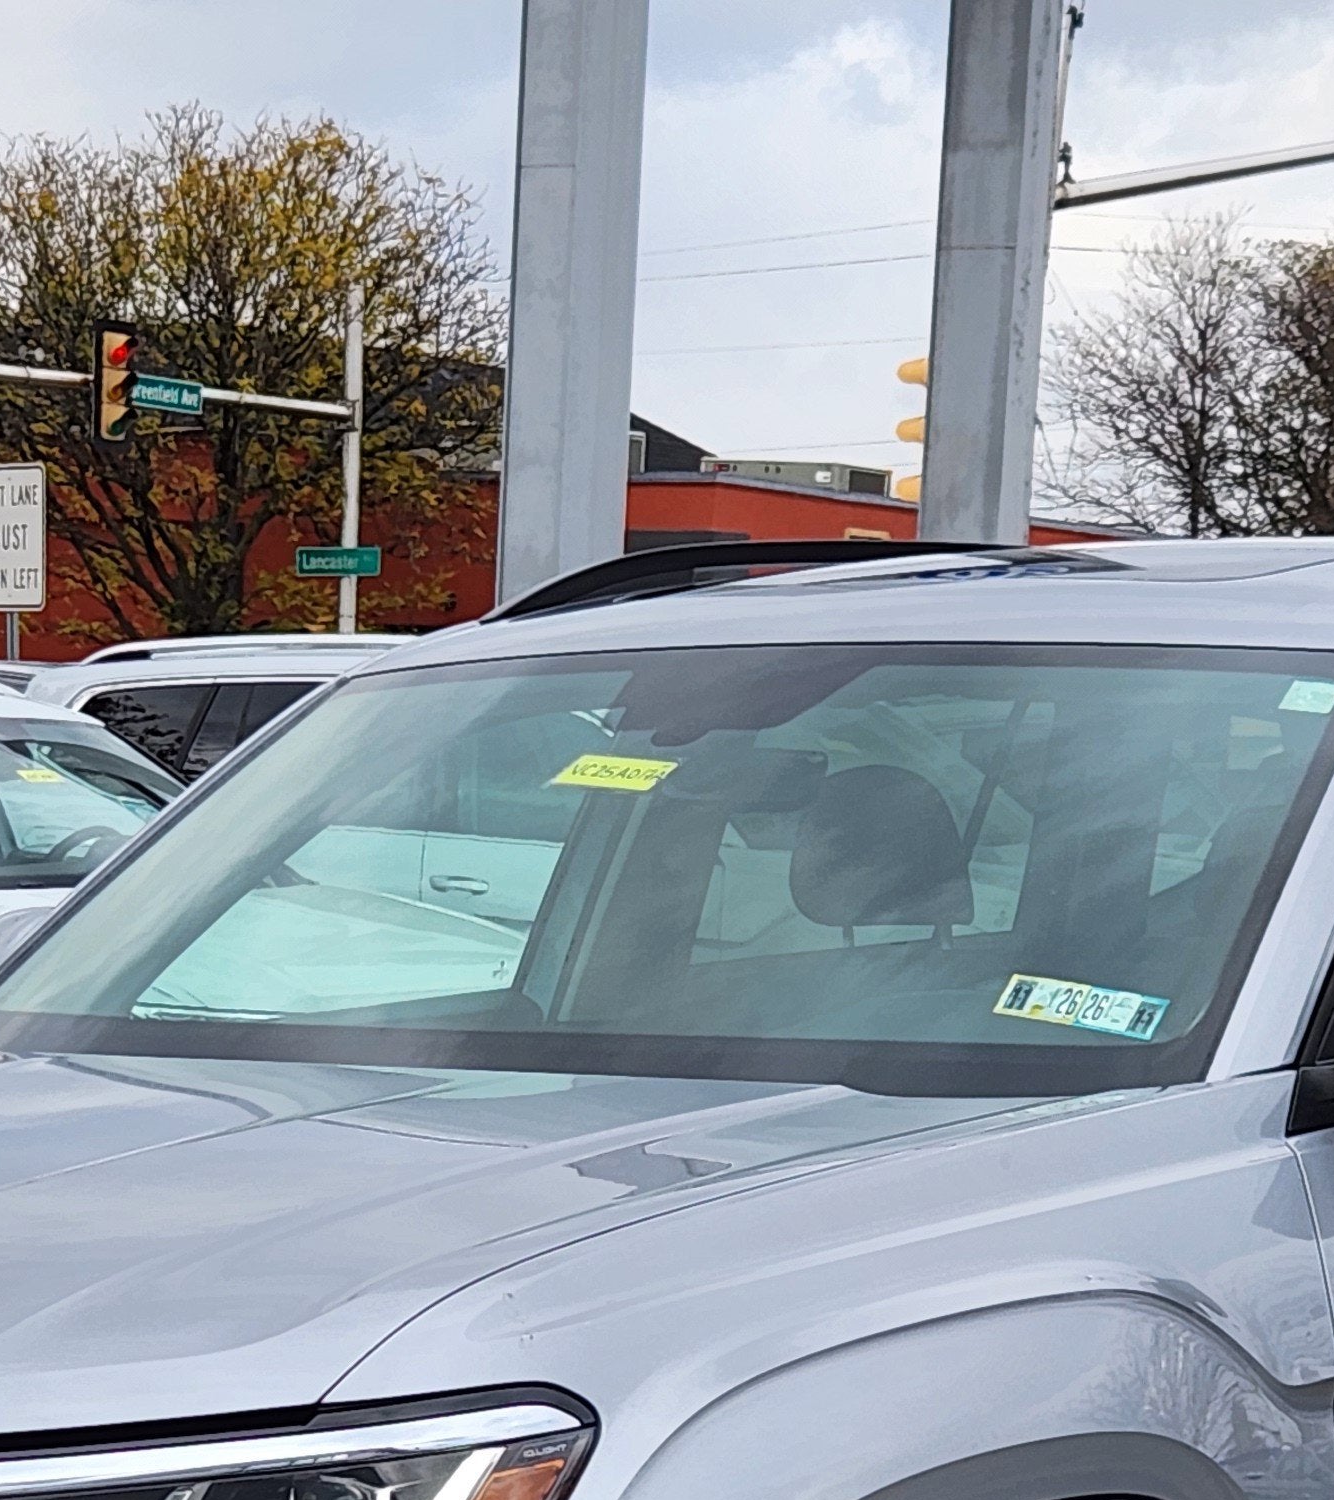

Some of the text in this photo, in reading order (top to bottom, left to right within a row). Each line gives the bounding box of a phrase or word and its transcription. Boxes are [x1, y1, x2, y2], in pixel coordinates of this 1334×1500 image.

[181, 388, 198, 407] Ave
[11, 484, 39, 506] LANE
[302, 553, 359, 570] Lancaster
[13, 568, 39, 589] LEFT
[1006, 983, 1083, 1015] 11 26
[1081, 993, 1158, 1034] 26 11
